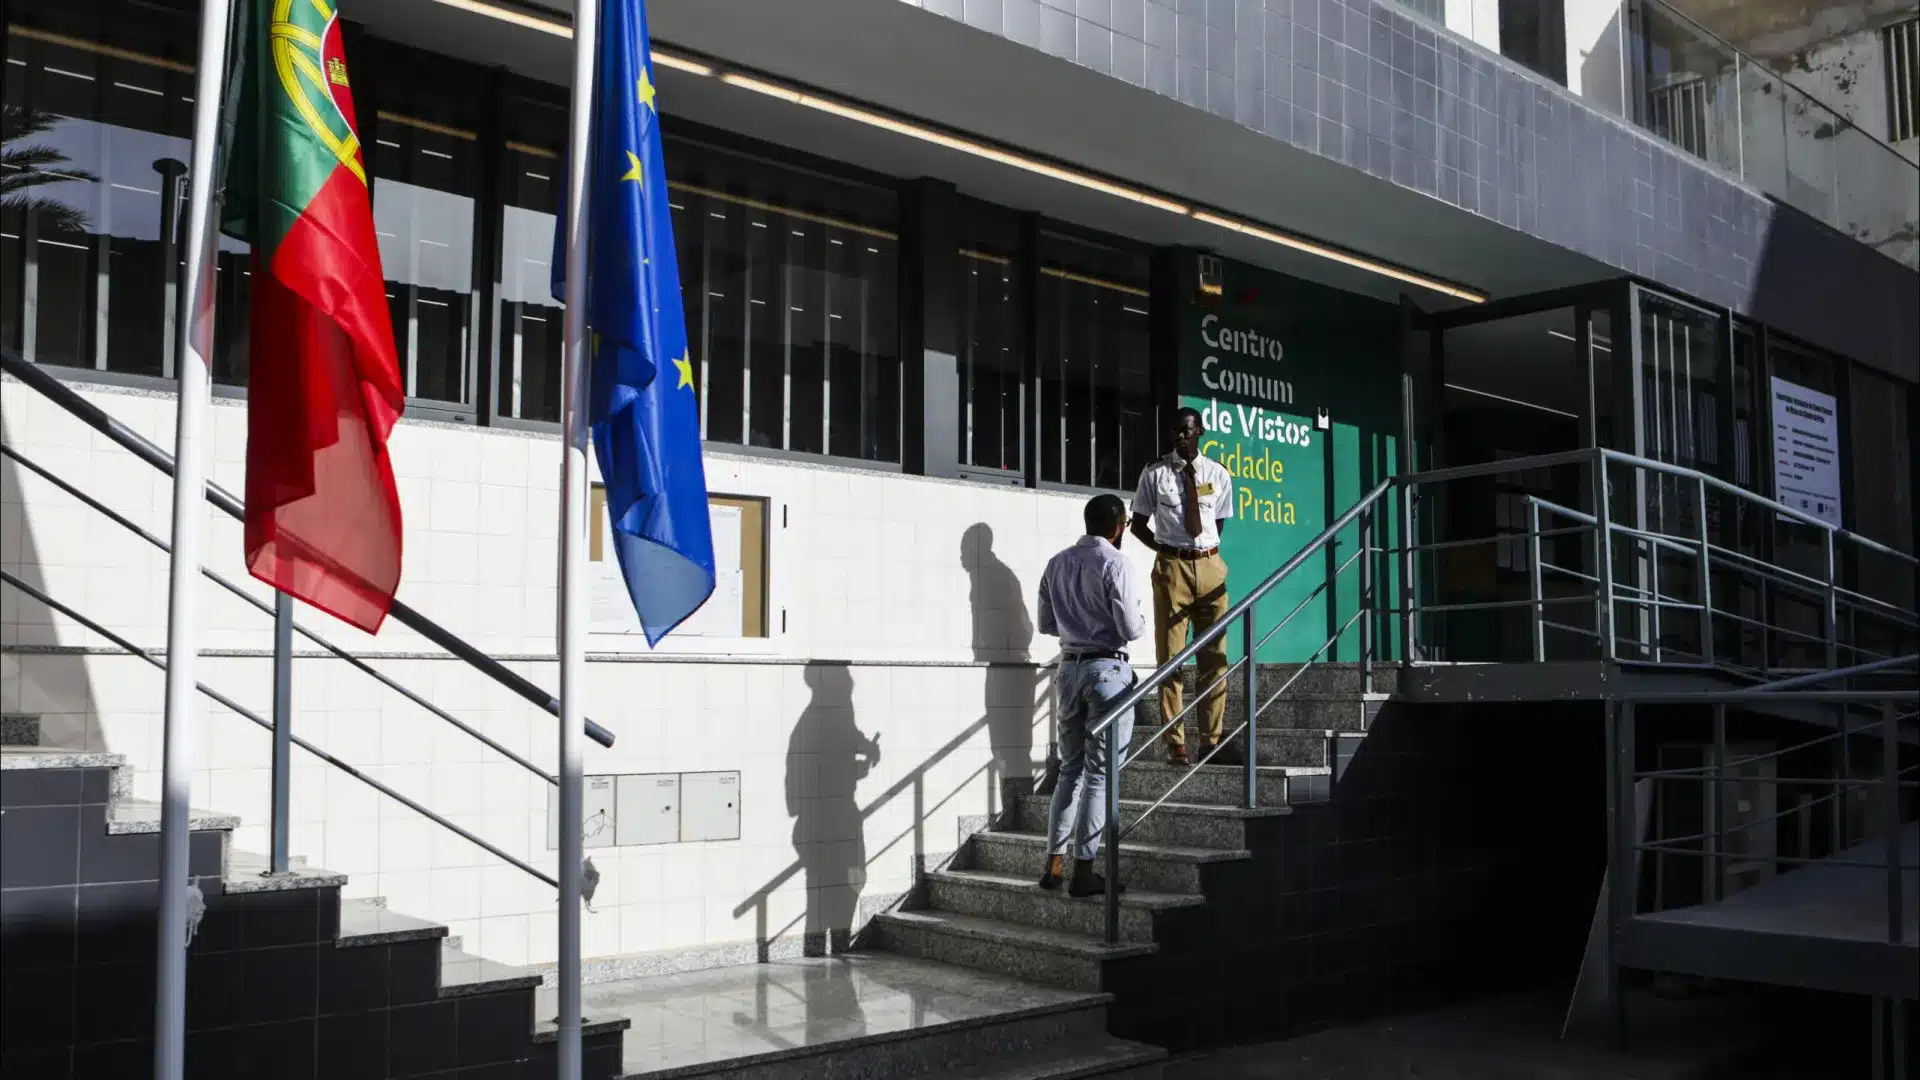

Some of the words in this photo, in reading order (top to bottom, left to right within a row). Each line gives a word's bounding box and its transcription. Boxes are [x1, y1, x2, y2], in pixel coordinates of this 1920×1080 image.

[1202, 314, 1283, 362] Centro
[1202, 356, 1293, 404] Comum
[1202, 397, 1233, 434] de
[1236, 403, 1310, 447] Vistos
[1239, 486, 1296, 525] Praia
